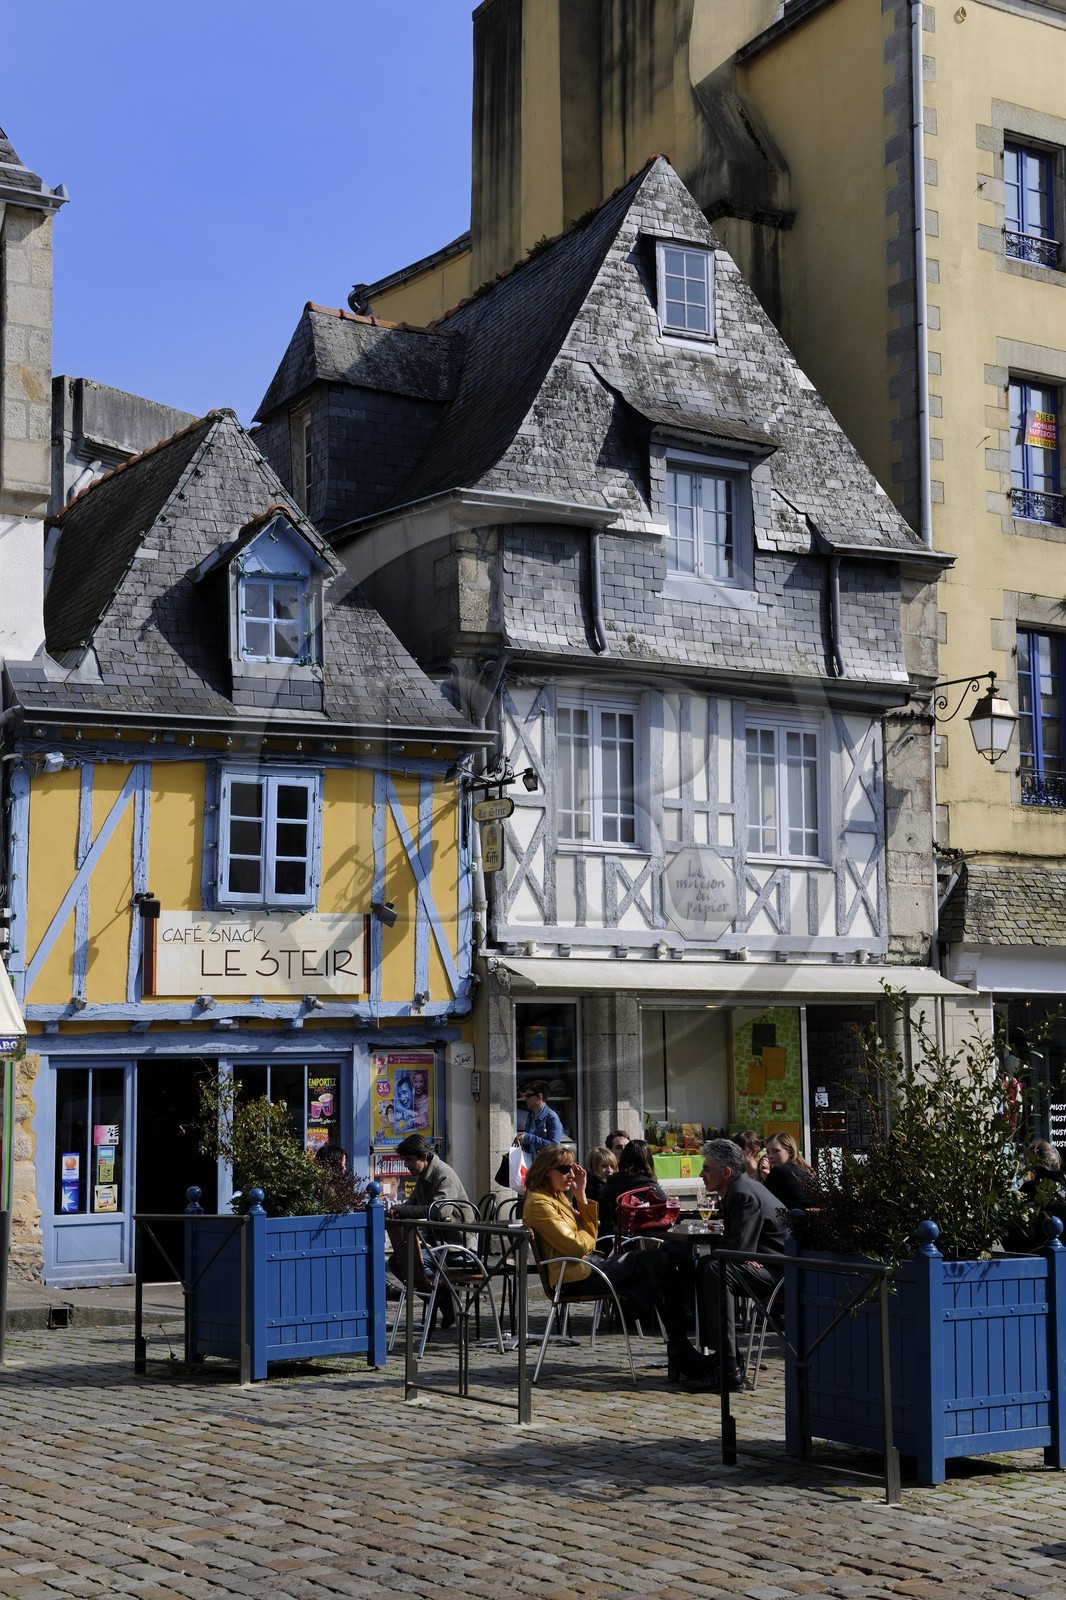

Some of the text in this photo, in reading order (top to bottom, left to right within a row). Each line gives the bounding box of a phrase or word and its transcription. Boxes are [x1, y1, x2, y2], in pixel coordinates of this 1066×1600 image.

[485, 850, 499, 864] Leffe
[675, 879, 726, 890] maison
[162, 925, 266, 944] CAFÉ SNACK
[201, 949, 358, 979] LE STEIR
[308, 1078, 336, 1087] EMPORTEZ
